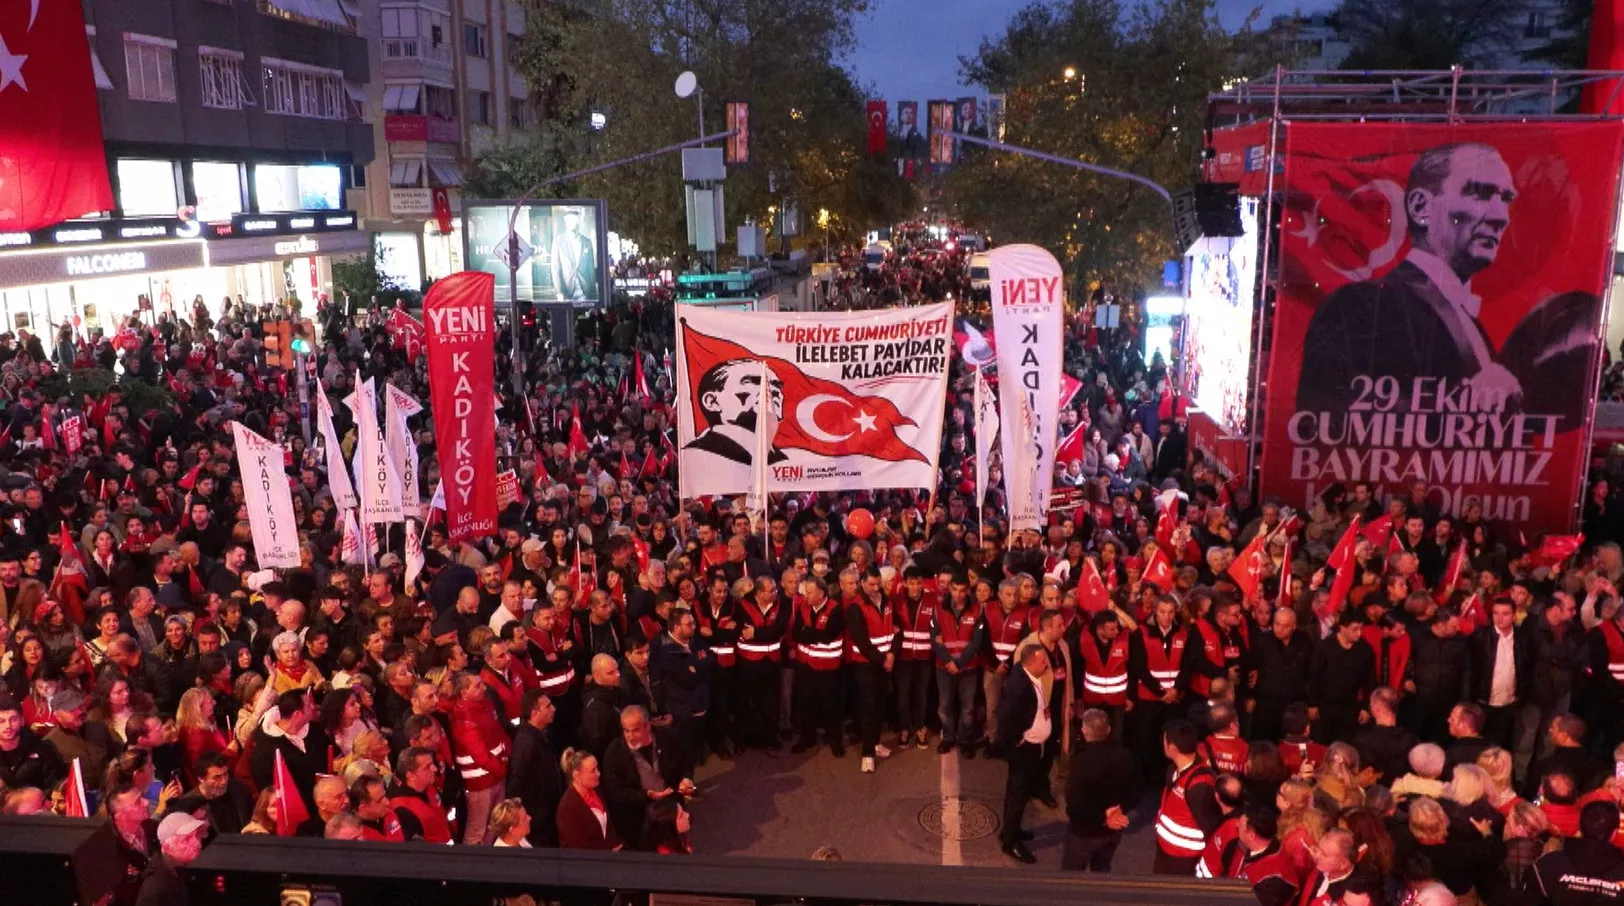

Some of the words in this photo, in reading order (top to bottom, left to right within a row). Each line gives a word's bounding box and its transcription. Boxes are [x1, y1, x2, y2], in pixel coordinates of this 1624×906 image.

[67, 252, 145, 275] FALCONERI
[776, 324, 840, 344] TÜRKİYE
[845, 315, 948, 342] CUMHURİYETİ
[796, 343, 869, 363] İLELEBET
[873, 337, 945, 361] PAYİDAR
[841, 356, 945, 380] KALACAKTIR!
[1350, 375, 1400, 411] 29
[1411, 376, 1507, 413] Ekim
[452, 351, 475, 506] KADIKÖY
[1291, 447, 1552, 485] BAYRAMIMIZ
[257, 456, 277, 541] KADIKÖY
